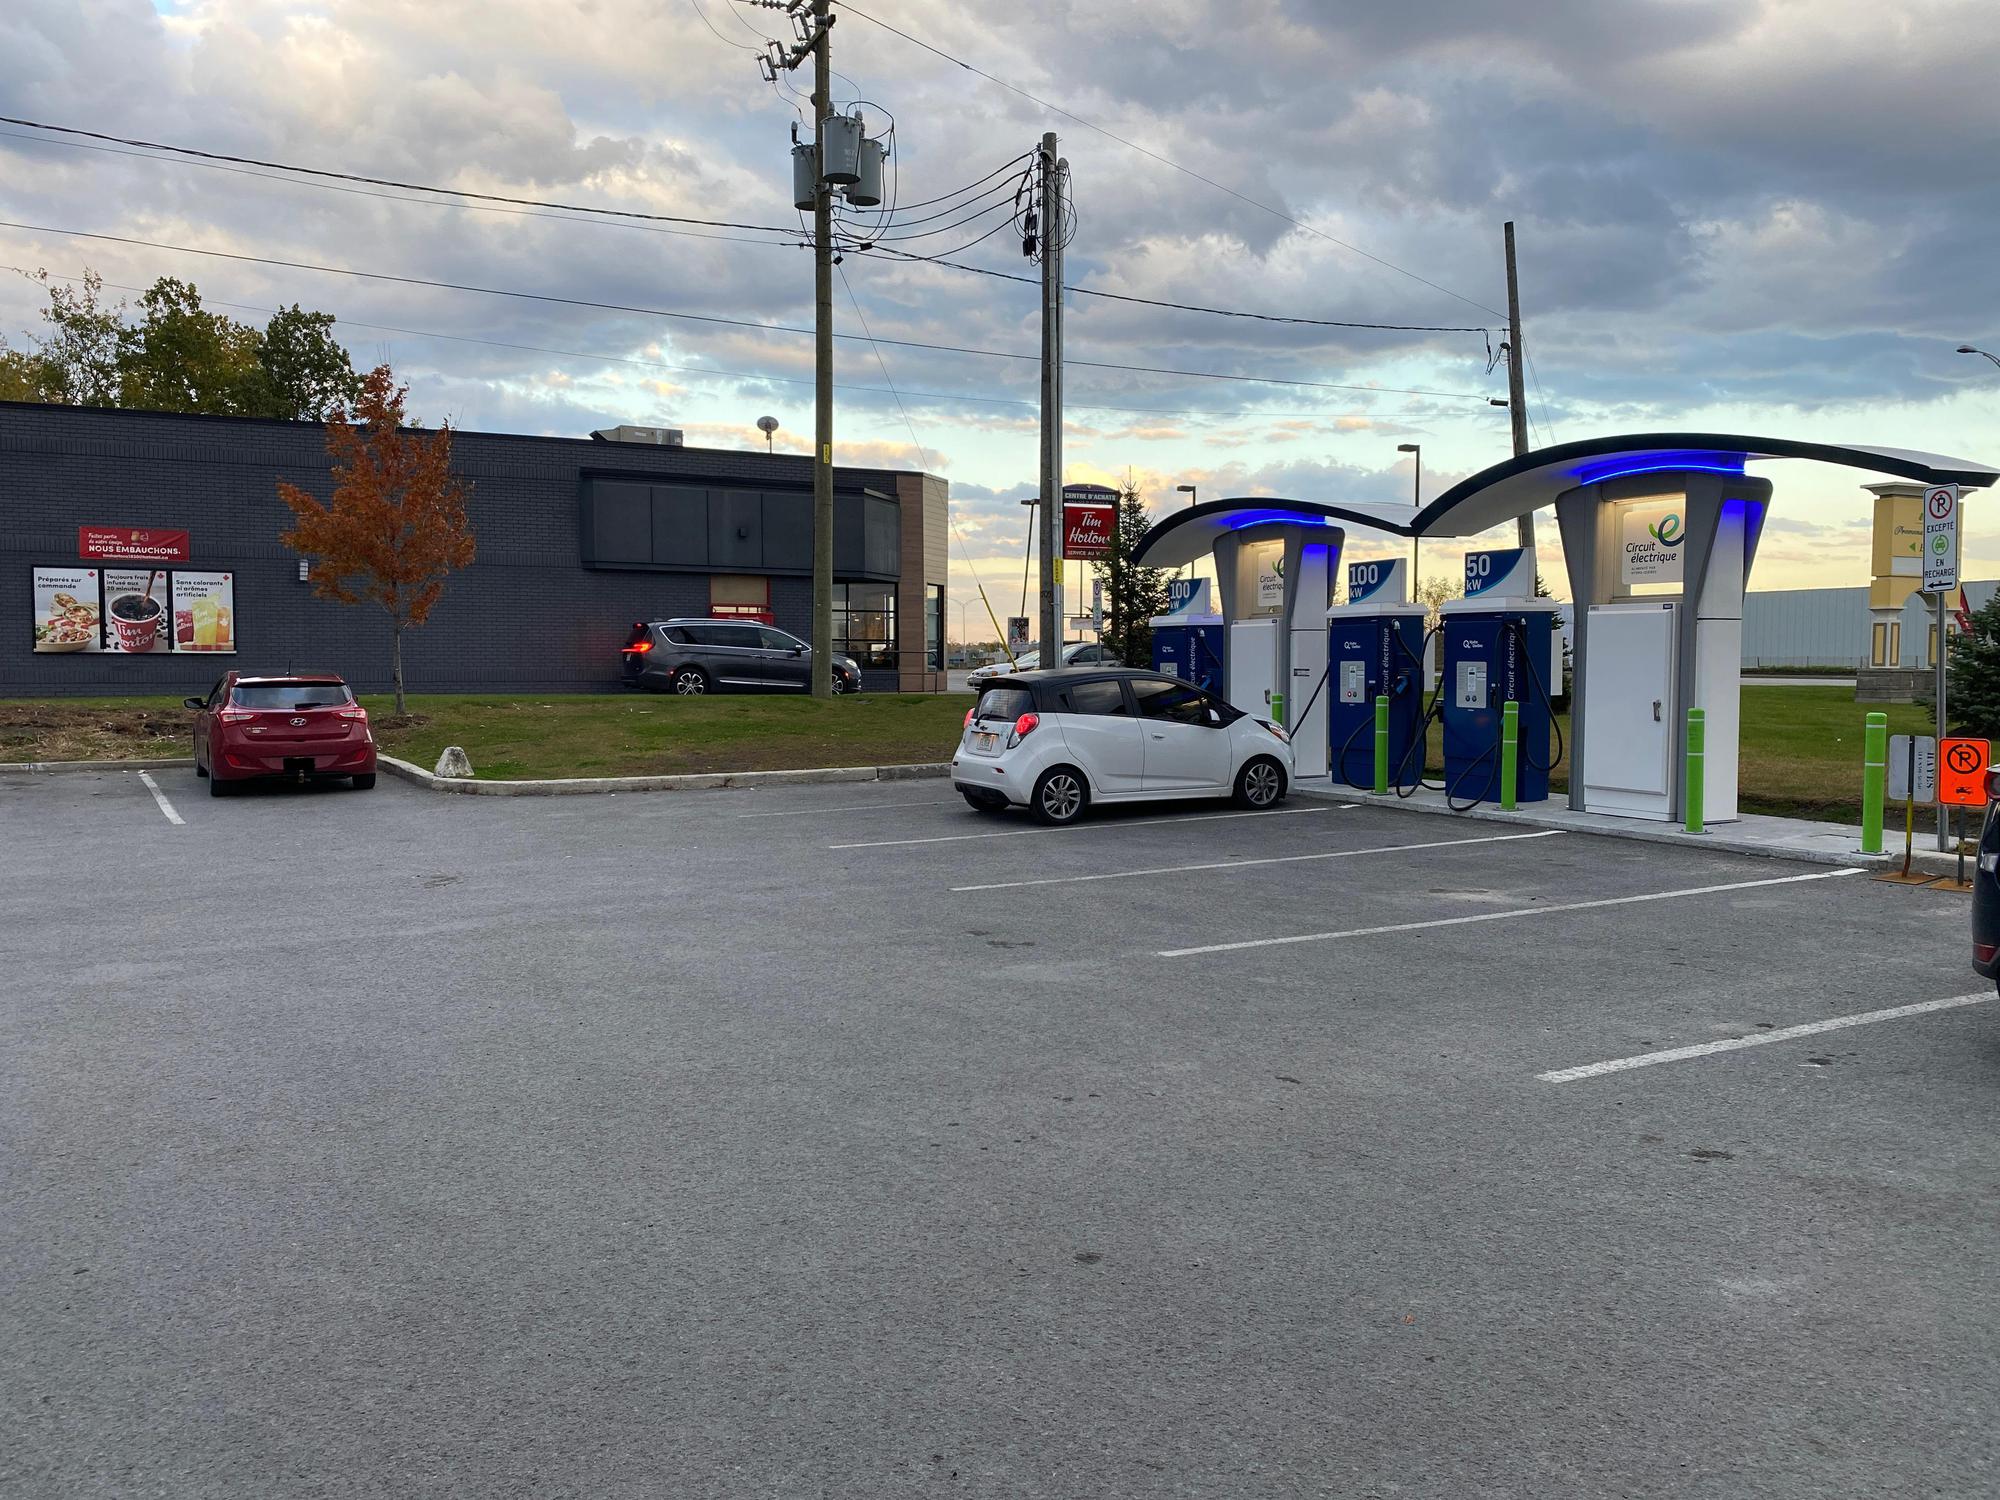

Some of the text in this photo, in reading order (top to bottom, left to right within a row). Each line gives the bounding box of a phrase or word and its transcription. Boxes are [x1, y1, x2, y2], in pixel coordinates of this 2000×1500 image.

[1081, 511, 1102, 528] Tim
[88, 545, 181, 554] NOUS EMBAUCHONS.
[1626, 541, 1656, 552] Circuit
[1631, 552, 1677, 564] électrique
[1935, 558, 1945, 567] EN
[1466, 554, 1491, 578] 50
[106, 573, 133, 581] Toujours
[1349, 564, 1379, 586] 100
[1924, 567, 1955, 579] RECHARGE
[1169, 581, 1191, 599] 100
[1466, 579, 1482, 590] kW
[1350, 587, 1363, 598] kW
[115, 620, 142, 636] Tim
[1381, 627, 1390, 668] électrique
[1507, 671, 1515, 700] Circuit
